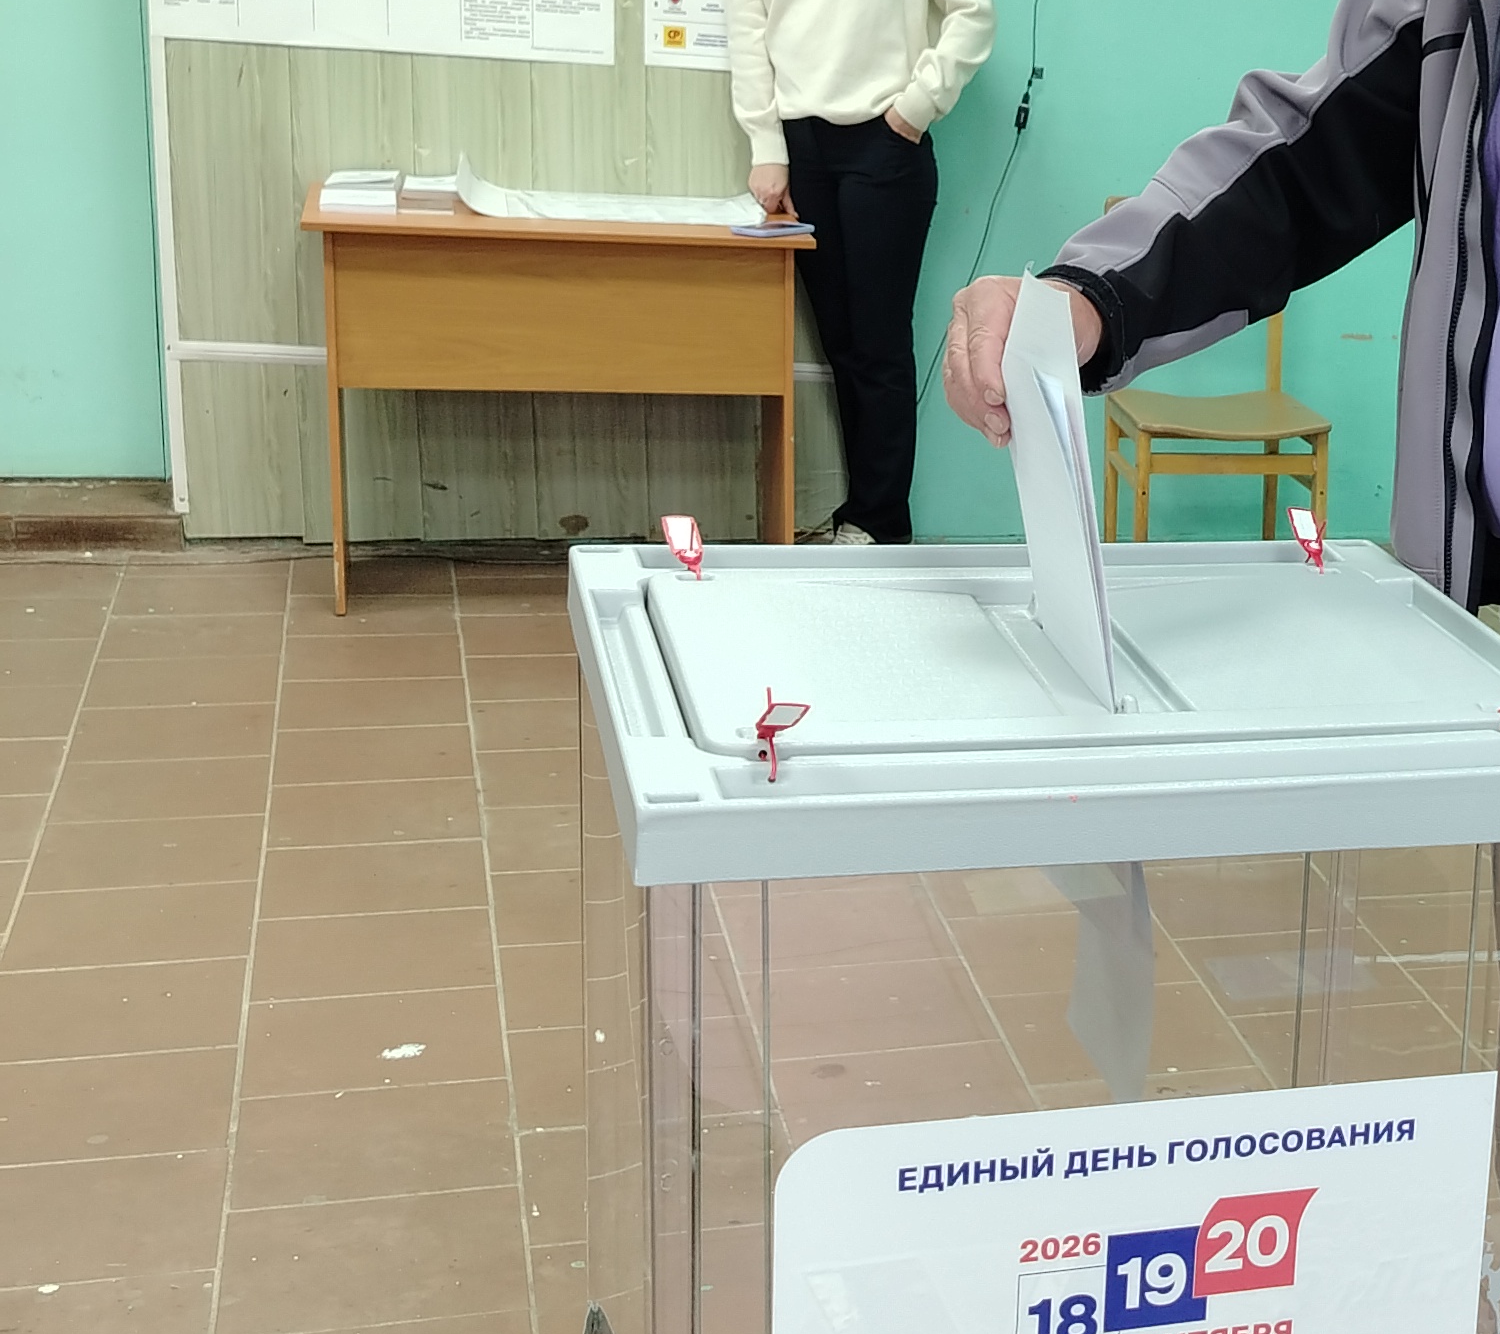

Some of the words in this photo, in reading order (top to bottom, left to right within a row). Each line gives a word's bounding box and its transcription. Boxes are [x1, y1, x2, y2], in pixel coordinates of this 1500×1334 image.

[898, 1148, 1055, 1193] ЕДИНЫЙ
[1063, 1142, 1158, 1181] ДЕНЬ
[1167, 1117, 1417, 1166] ГОЛОСОВАНИЯ
[1019, 1232, 1102, 1264] 2026
[1116, 1251, 1188, 1309] 19
[1204, 1214, 1292, 1274] 20
